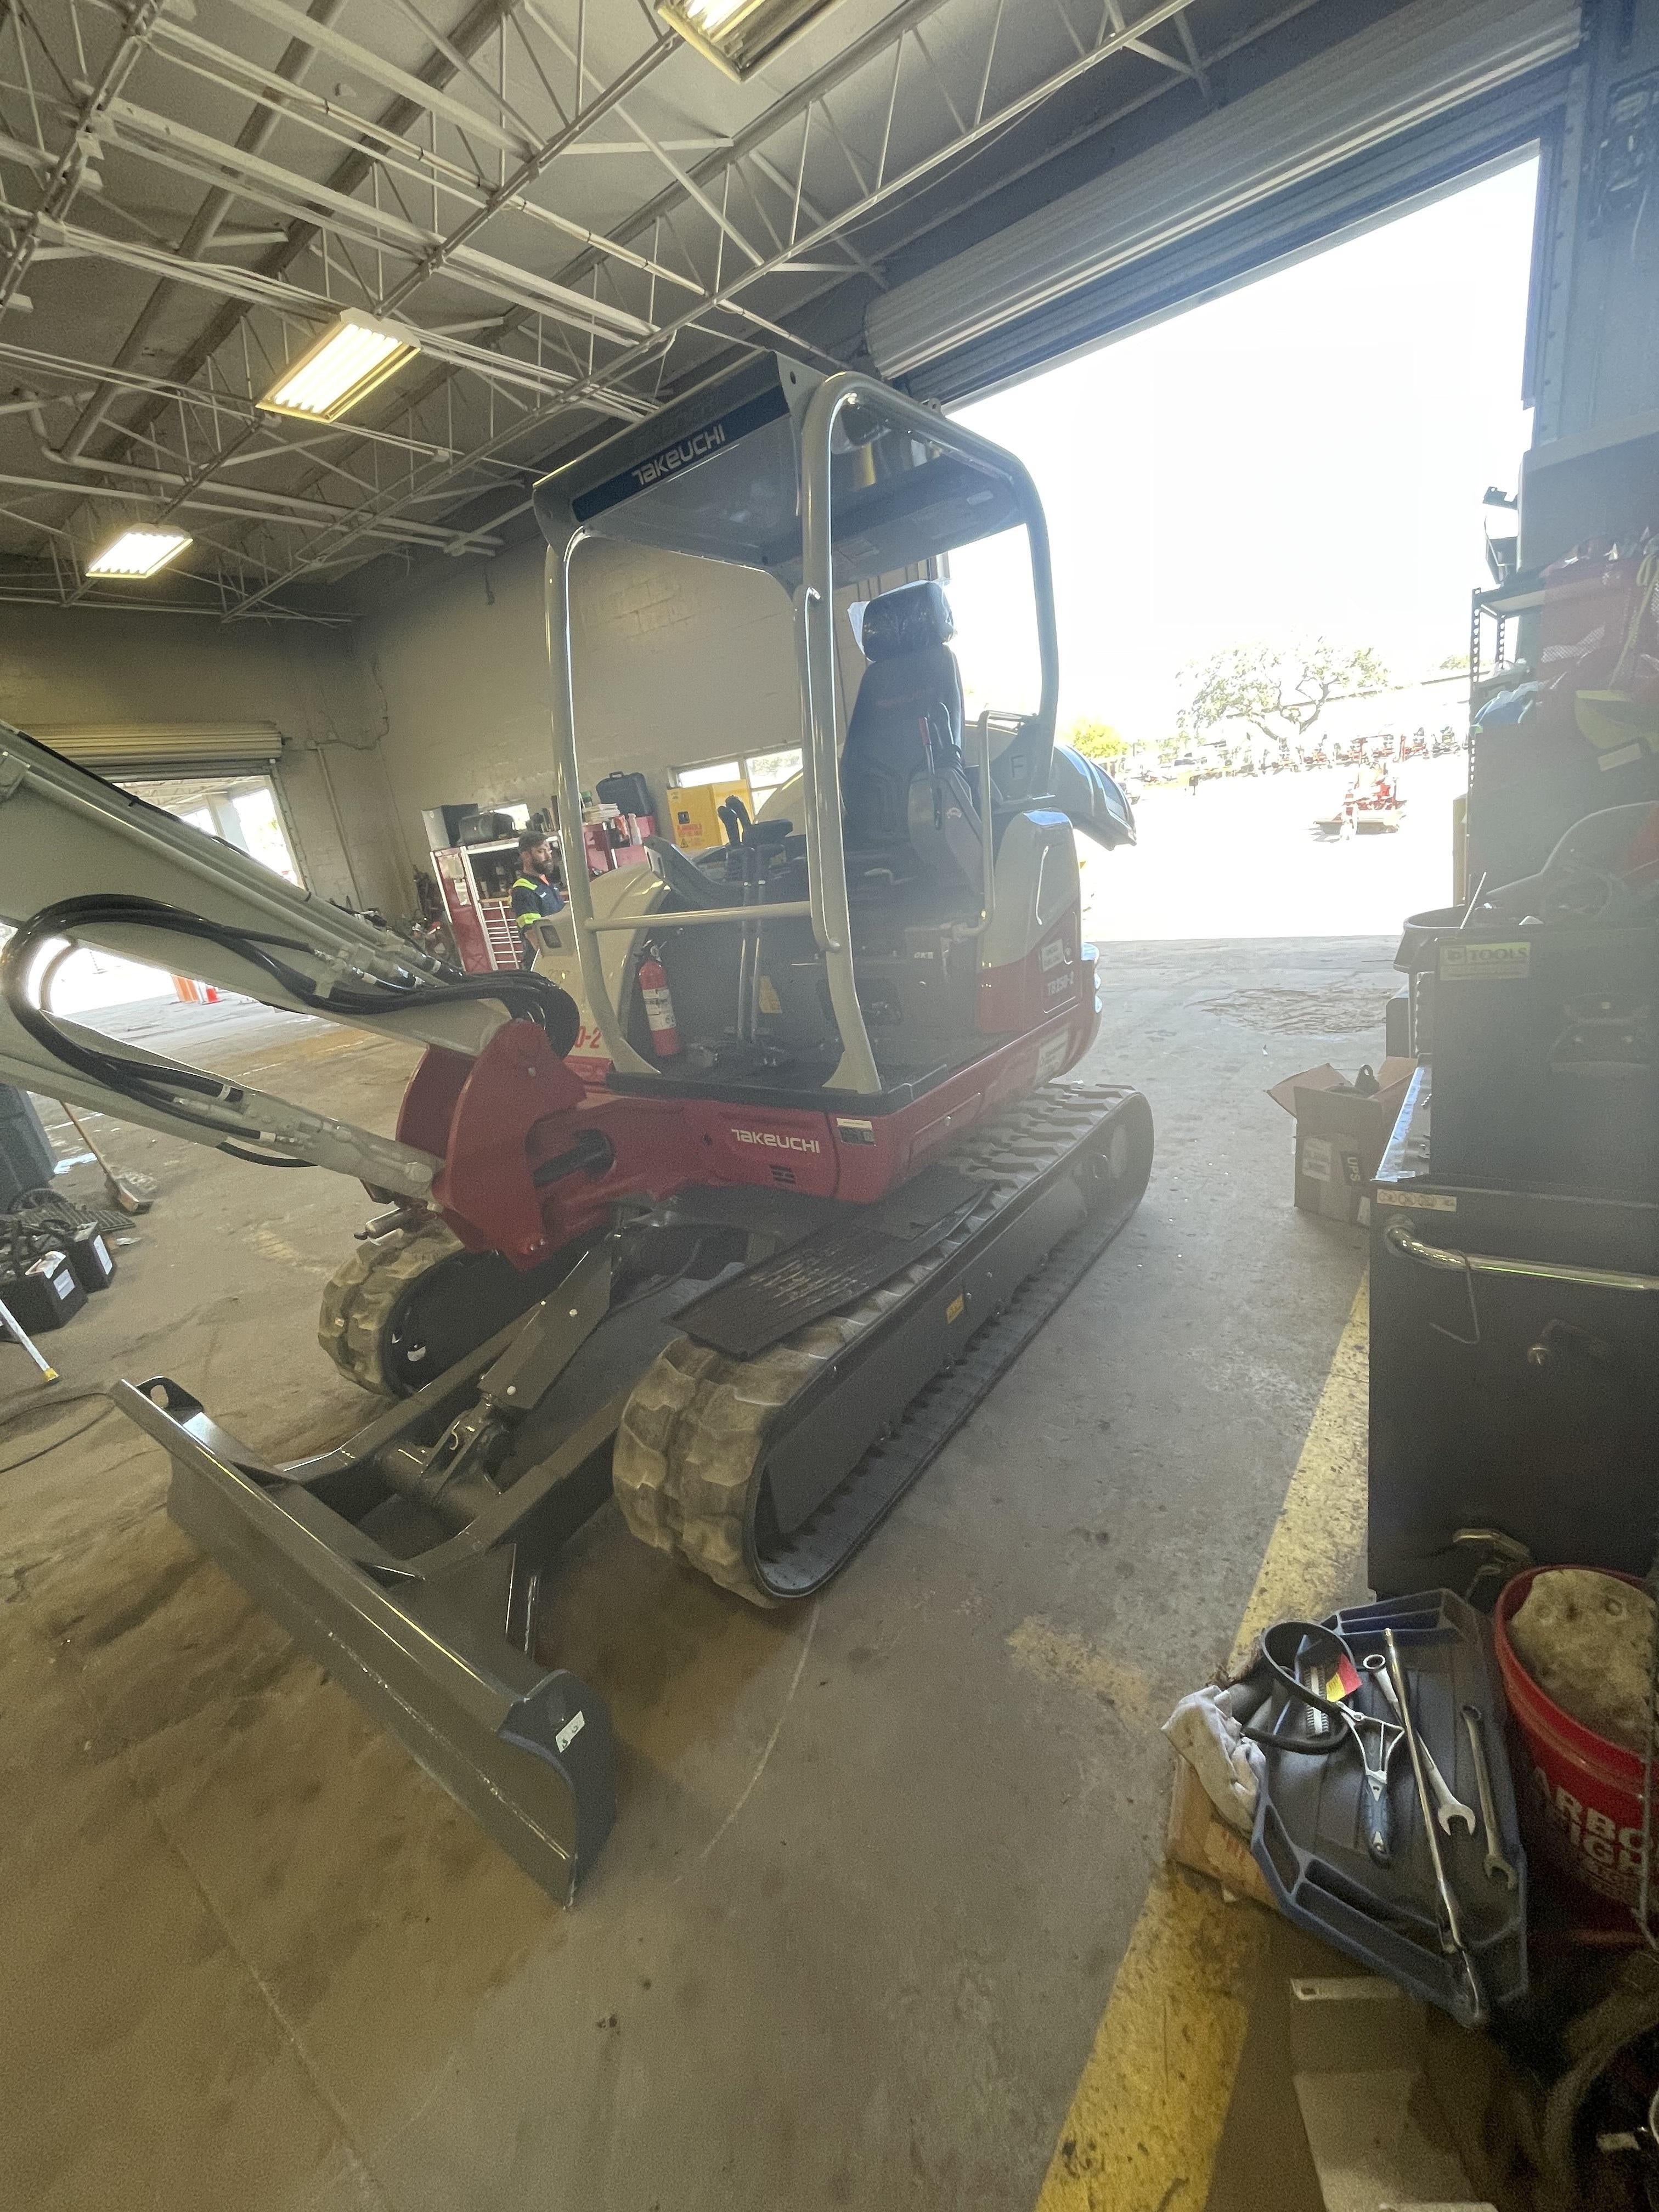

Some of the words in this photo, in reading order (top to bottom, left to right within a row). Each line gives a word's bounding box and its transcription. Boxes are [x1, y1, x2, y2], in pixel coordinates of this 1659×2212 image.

[631, 424, 725, 484] TAKEUCHI
[1469, 947, 1527, 961] TOOLS
[731, 1128, 821, 1154] TAKEUCHI
[1347, 1156, 1361, 1182] UPS
